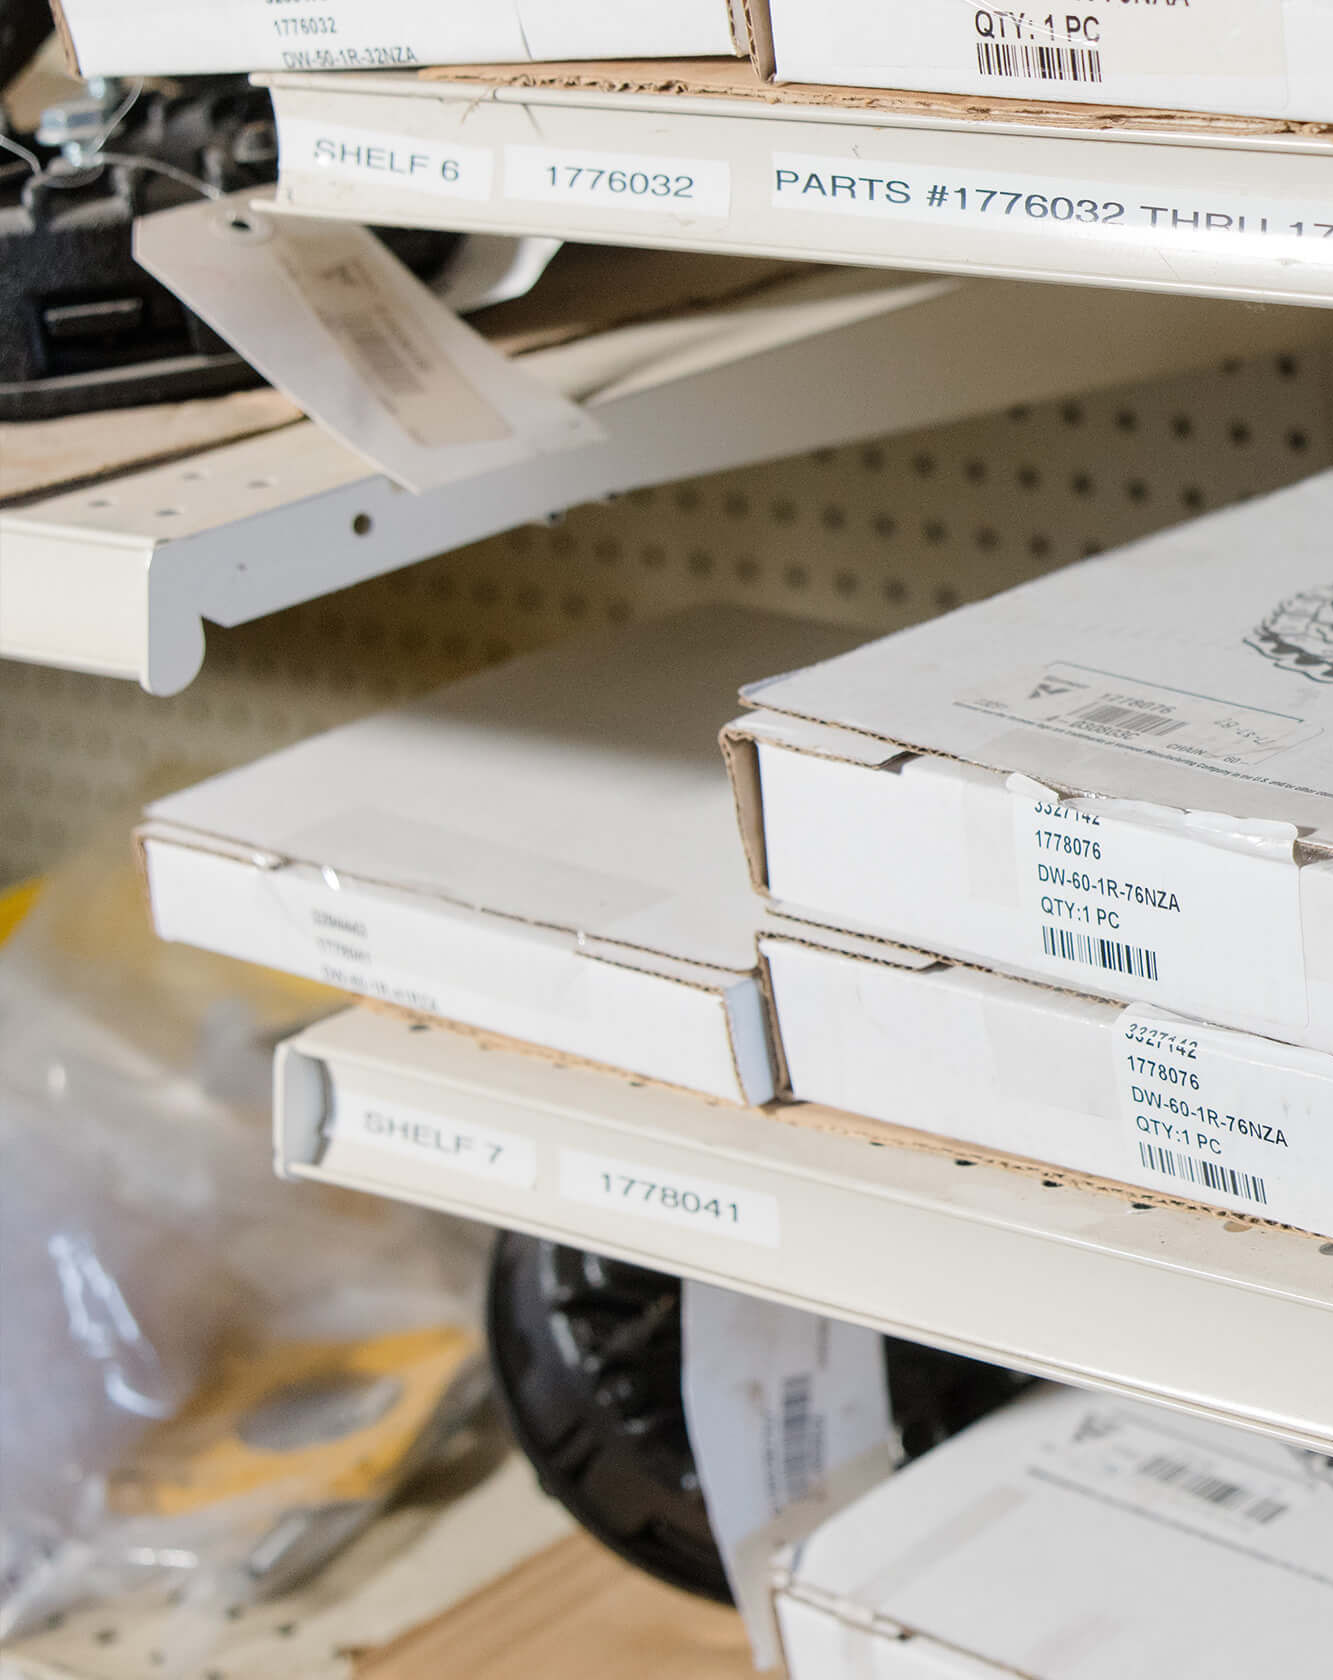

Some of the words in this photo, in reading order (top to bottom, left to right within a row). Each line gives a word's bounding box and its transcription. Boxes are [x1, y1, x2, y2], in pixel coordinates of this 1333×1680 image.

[273, 16, 337, 37] 1776032
[974, 9, 1035, 40] QTY:
[1044, 14, 1056, 41] 1
[1066, 15, 1101, 43] PC
[313, 138, 430, 176] SHELF
[440, 158, 461, 183] 6
[545, 164, 695, 199] 1776032
[775, 168, 912, 204] PARTS
[926, 183, 1126, 226] #1776032
[1034, 829, 1102, 860] 1778076
[1037, 863, 1181, 912] DW-60-1R-76NZA
[1040, 895, 1090, 923] QTY:1
[1096, 908, 1121, 929] PC
[1127, 1055, 1200, 1091] 1778076
[1131, 1085, 1289, 1148] DW-60-1R-76NZA
[1136, 1115, 1190, 1145] QTY:1
[1196, 1132, 1223, 1155] PC
[363, 1110, 474, 1155] SHELF
[483, 1144, 504, 1164] 7
[601, 1172, 741, 1223] 1778041
